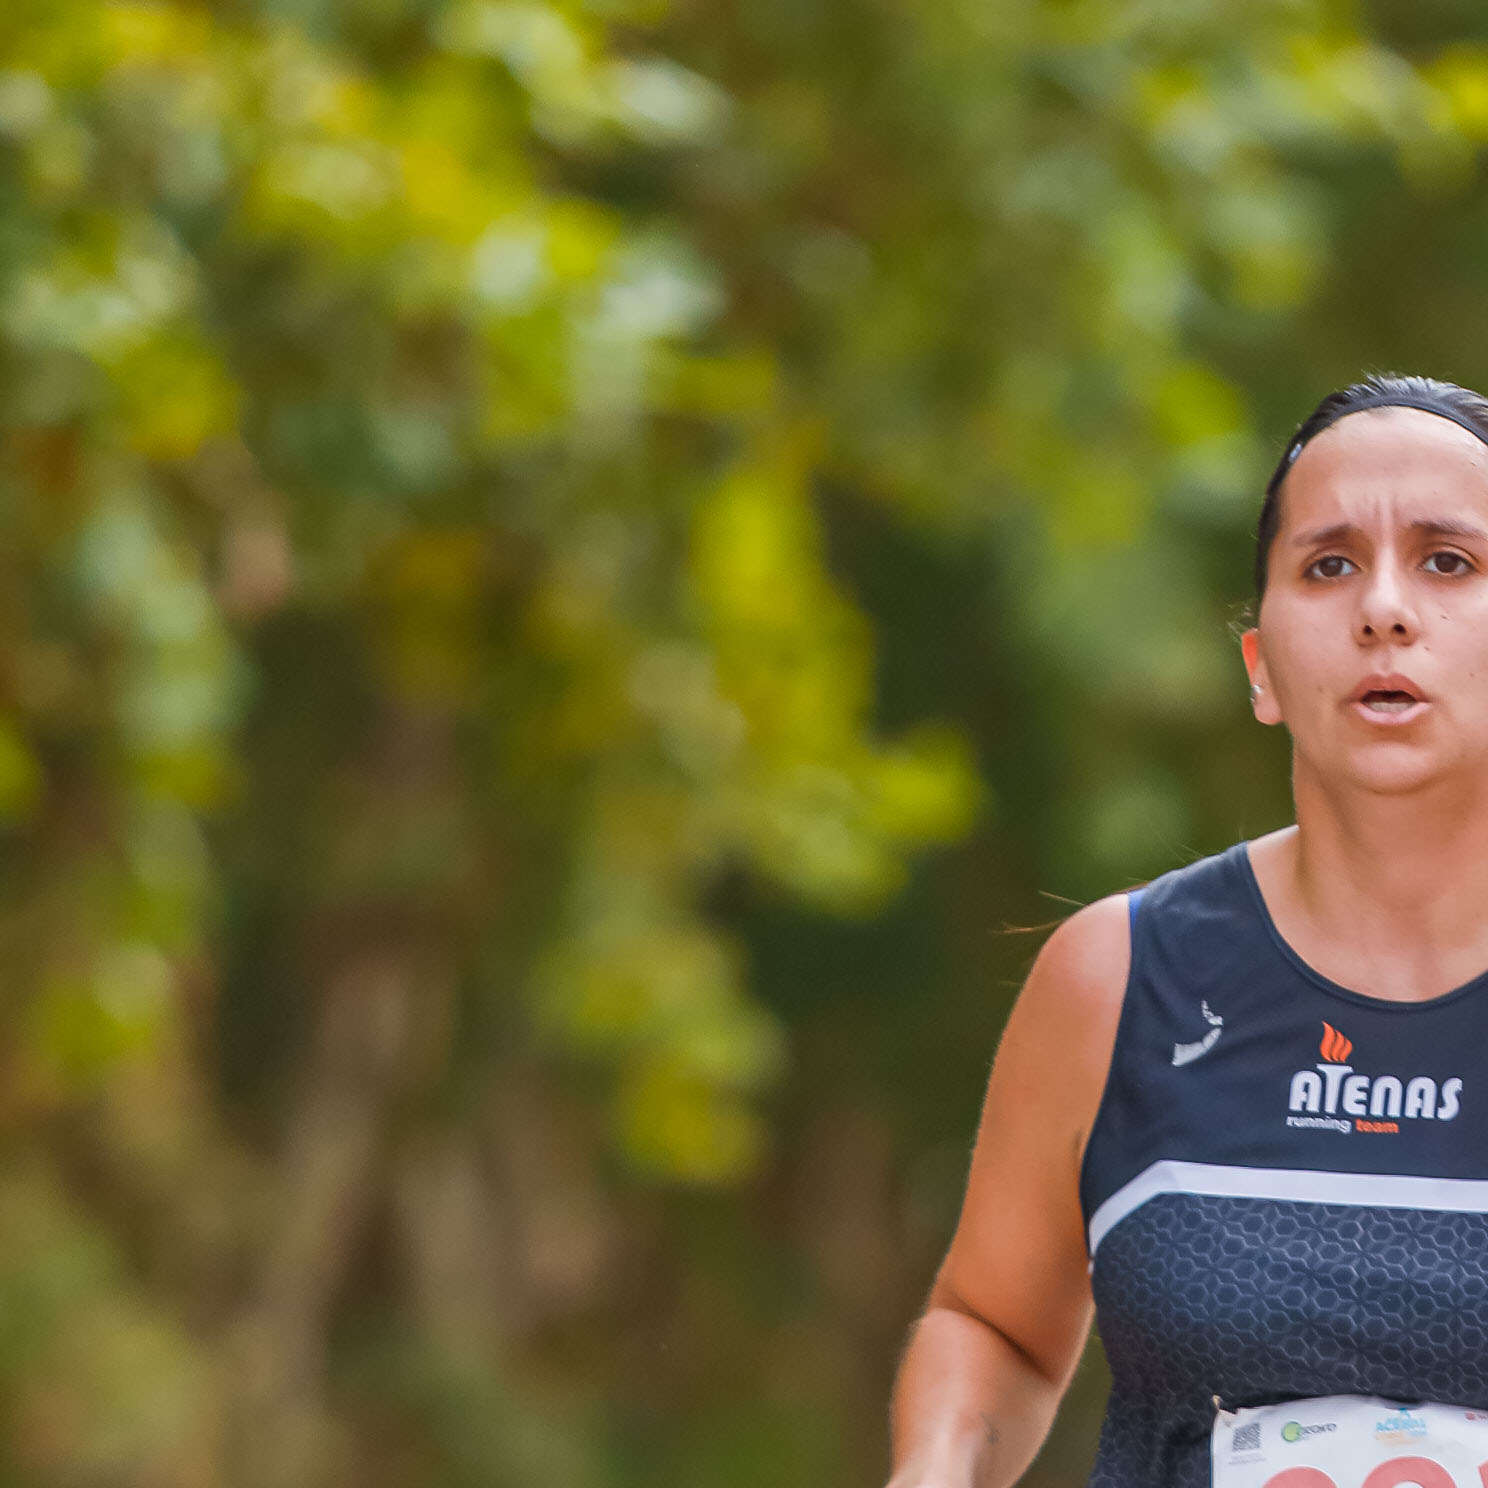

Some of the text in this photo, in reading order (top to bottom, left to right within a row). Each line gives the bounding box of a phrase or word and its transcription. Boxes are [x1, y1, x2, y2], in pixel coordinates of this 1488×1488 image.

[1289, 1063, 1463, 1121] ATENAS
[1286, 1115, 1399, 1134] running team
